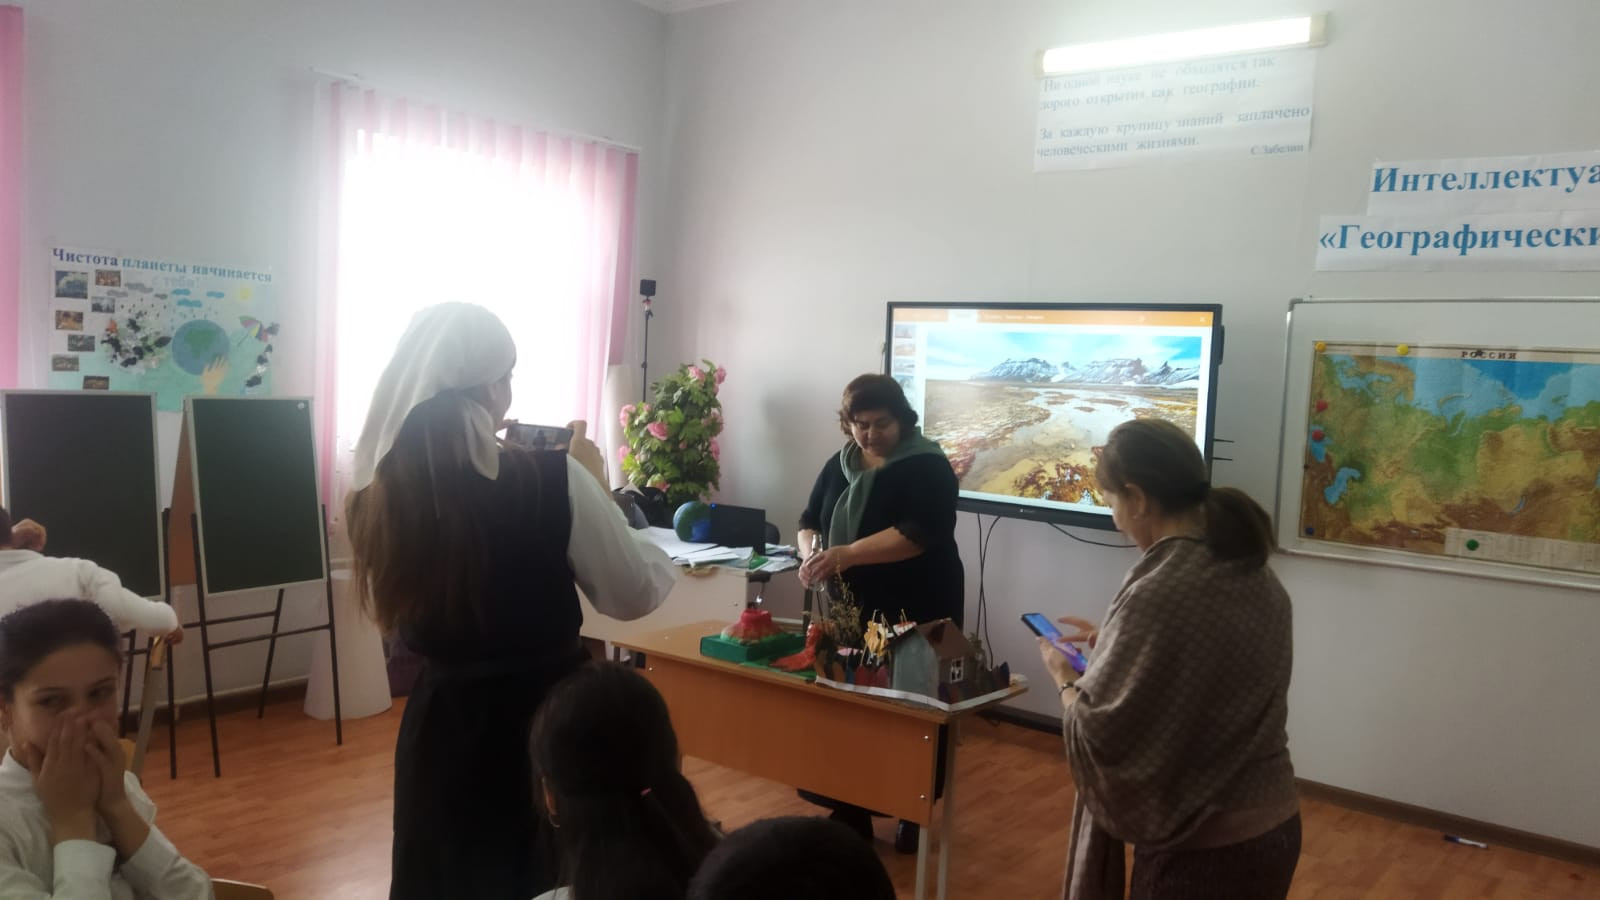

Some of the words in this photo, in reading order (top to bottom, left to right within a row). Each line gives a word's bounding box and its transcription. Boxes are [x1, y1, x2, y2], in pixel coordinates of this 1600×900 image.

[1040, 127, 1053, 140] За
[1060, 125, 1109, 139] каждую
[1117, 120, 1170, 136] крупицу
[1237, 105, 1310, 122] заплачено
[1037, 141, 1128, 157] человеческими
[53, 247, 118, 267] Чистота
[122, 258, 187, 274] планеты
[192, 264, 272, 283] начинается
